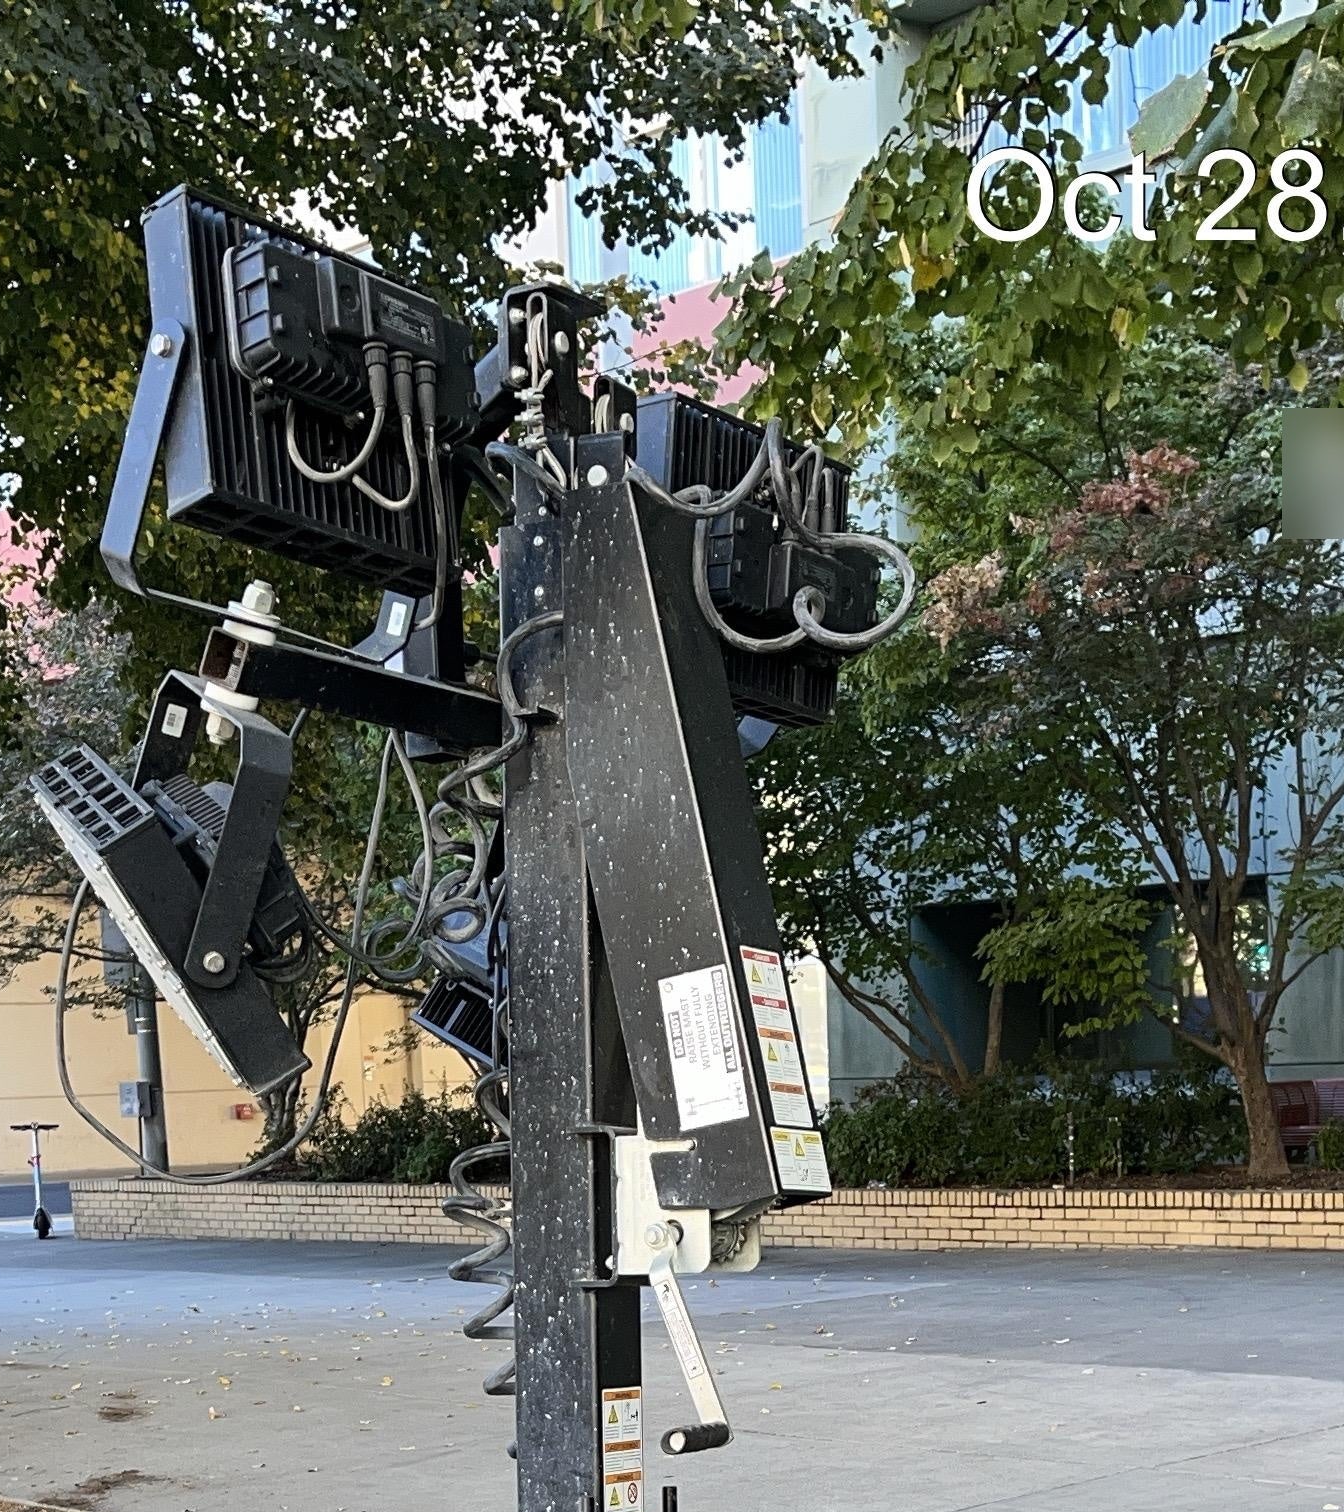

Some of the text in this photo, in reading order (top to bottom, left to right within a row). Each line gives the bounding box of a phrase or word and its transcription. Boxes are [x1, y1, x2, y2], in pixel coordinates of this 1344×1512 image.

[669, 1013, 685, 1056] DO NOT
[680, 998, 697, 1063] RAISE MAST
[691, 986, 711, 1070] WITHOUT FULLY
[705, 994, 721, 1056] EXTENDING
[712, 970, 737, 1072] ALL OUTRIGGERS
